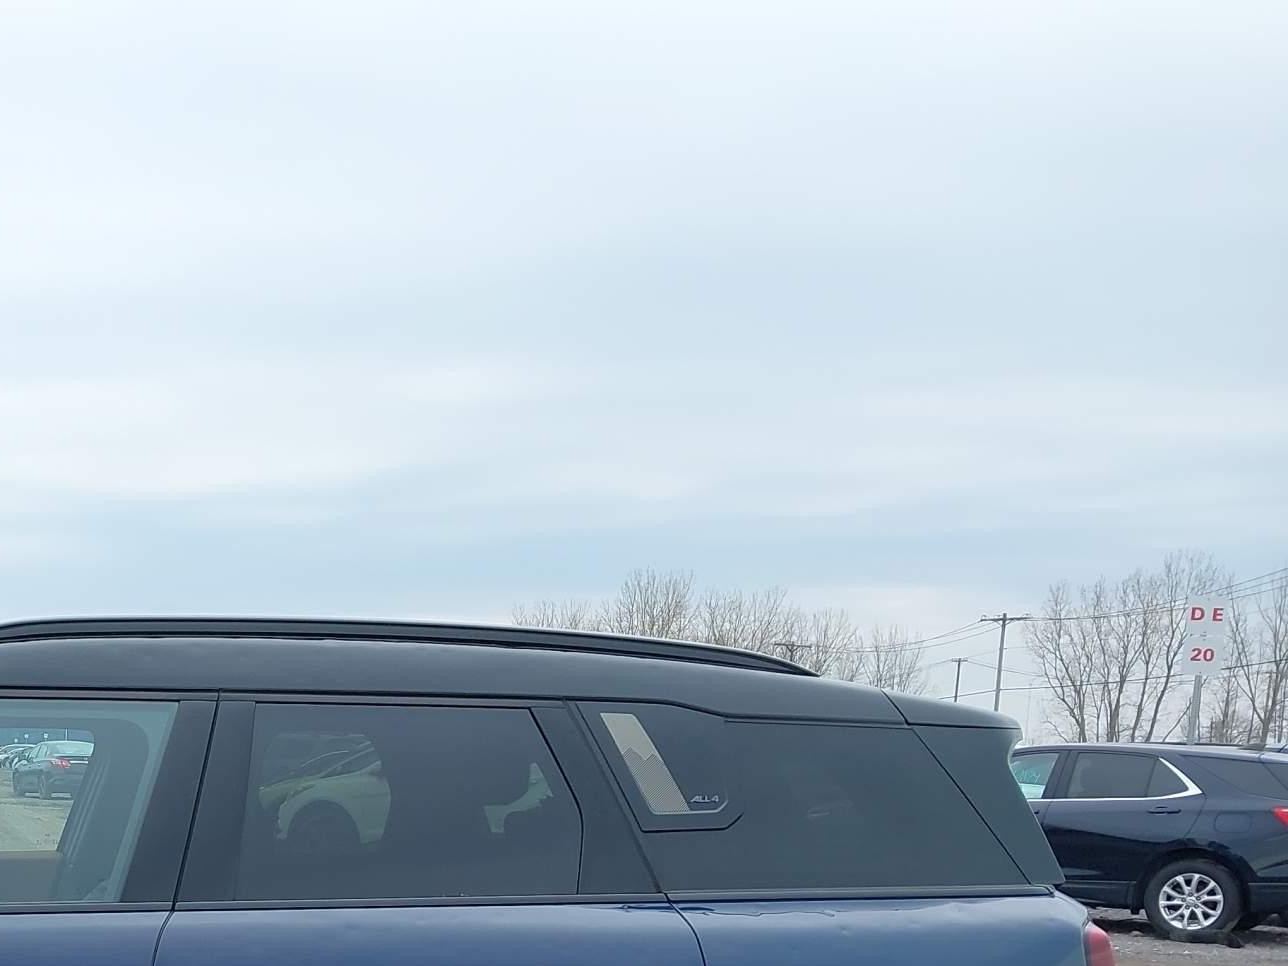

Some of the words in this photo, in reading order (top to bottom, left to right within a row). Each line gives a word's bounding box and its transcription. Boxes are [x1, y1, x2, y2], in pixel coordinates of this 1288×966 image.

[1190, 606, 1205, 621] D
[1212, 607, 1225, 622] E
[1190, 647, 1215, 662] 20
